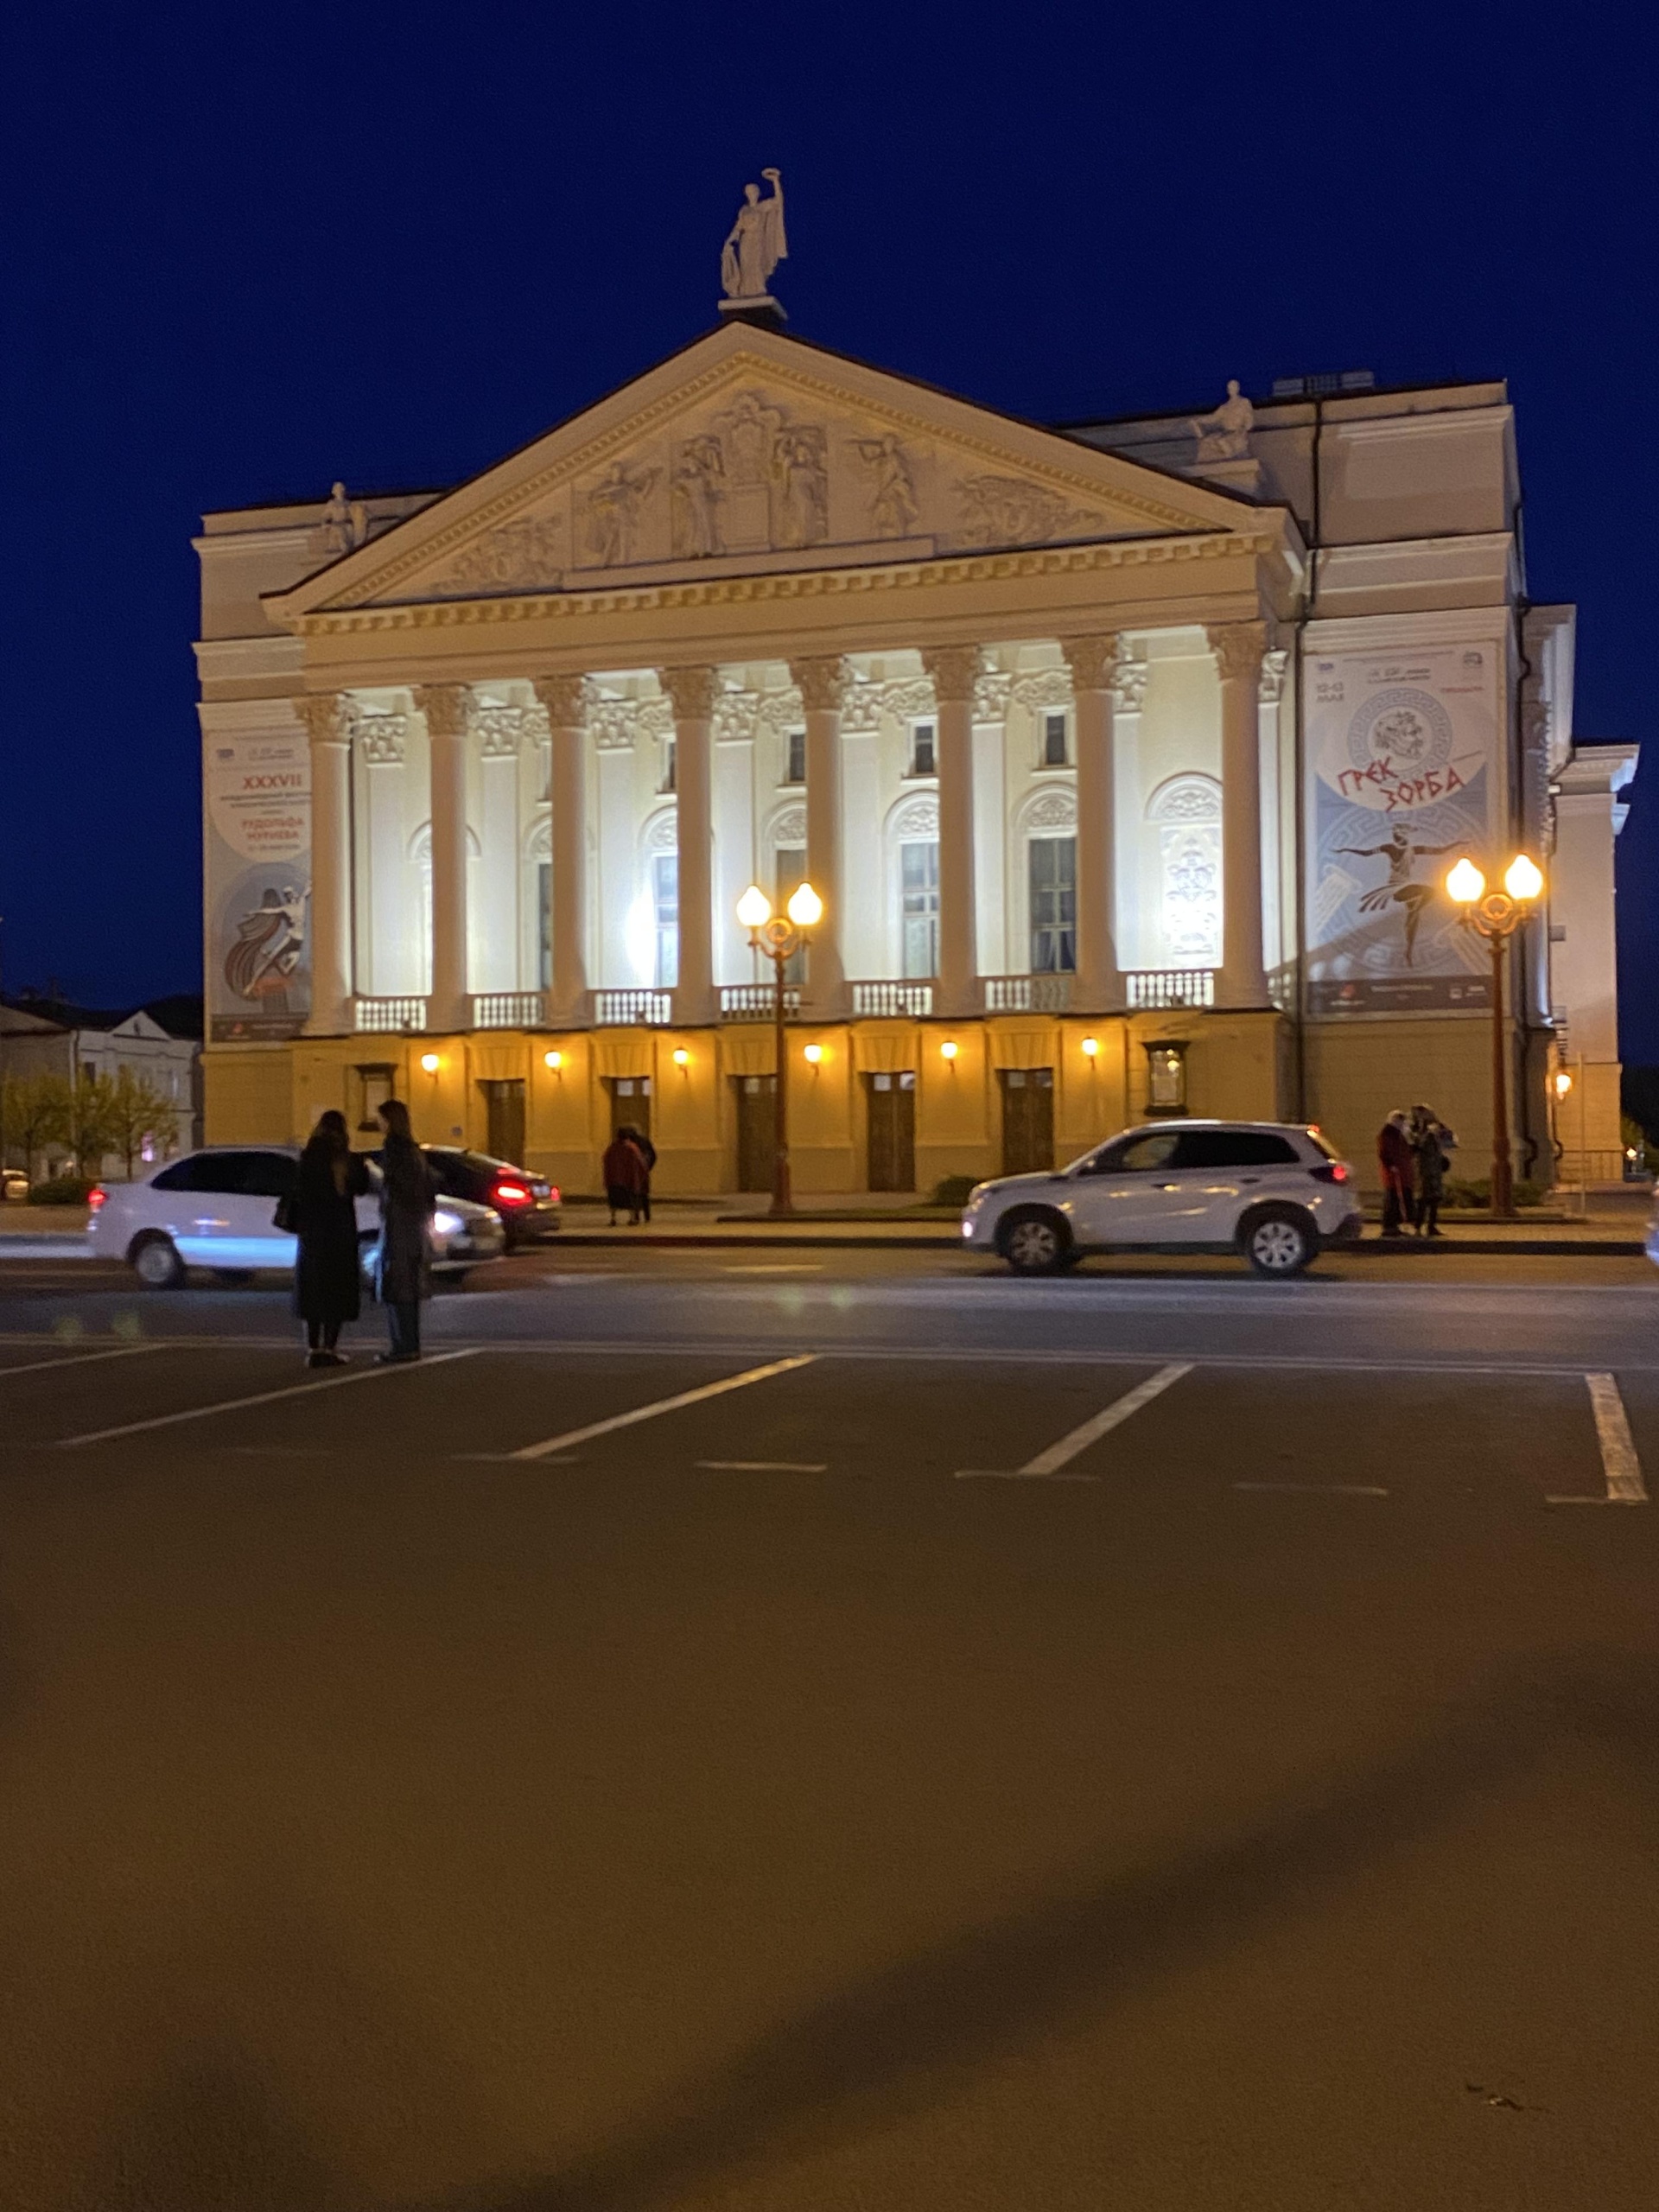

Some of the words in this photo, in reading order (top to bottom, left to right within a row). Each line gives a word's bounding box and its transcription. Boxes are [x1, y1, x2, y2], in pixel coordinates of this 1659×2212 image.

[244, 774, 302, 789] XXXVII
[1338, 756, 1399, 796] ГРЕК
[1380, 767, 1465, 812] ЗОРБА
